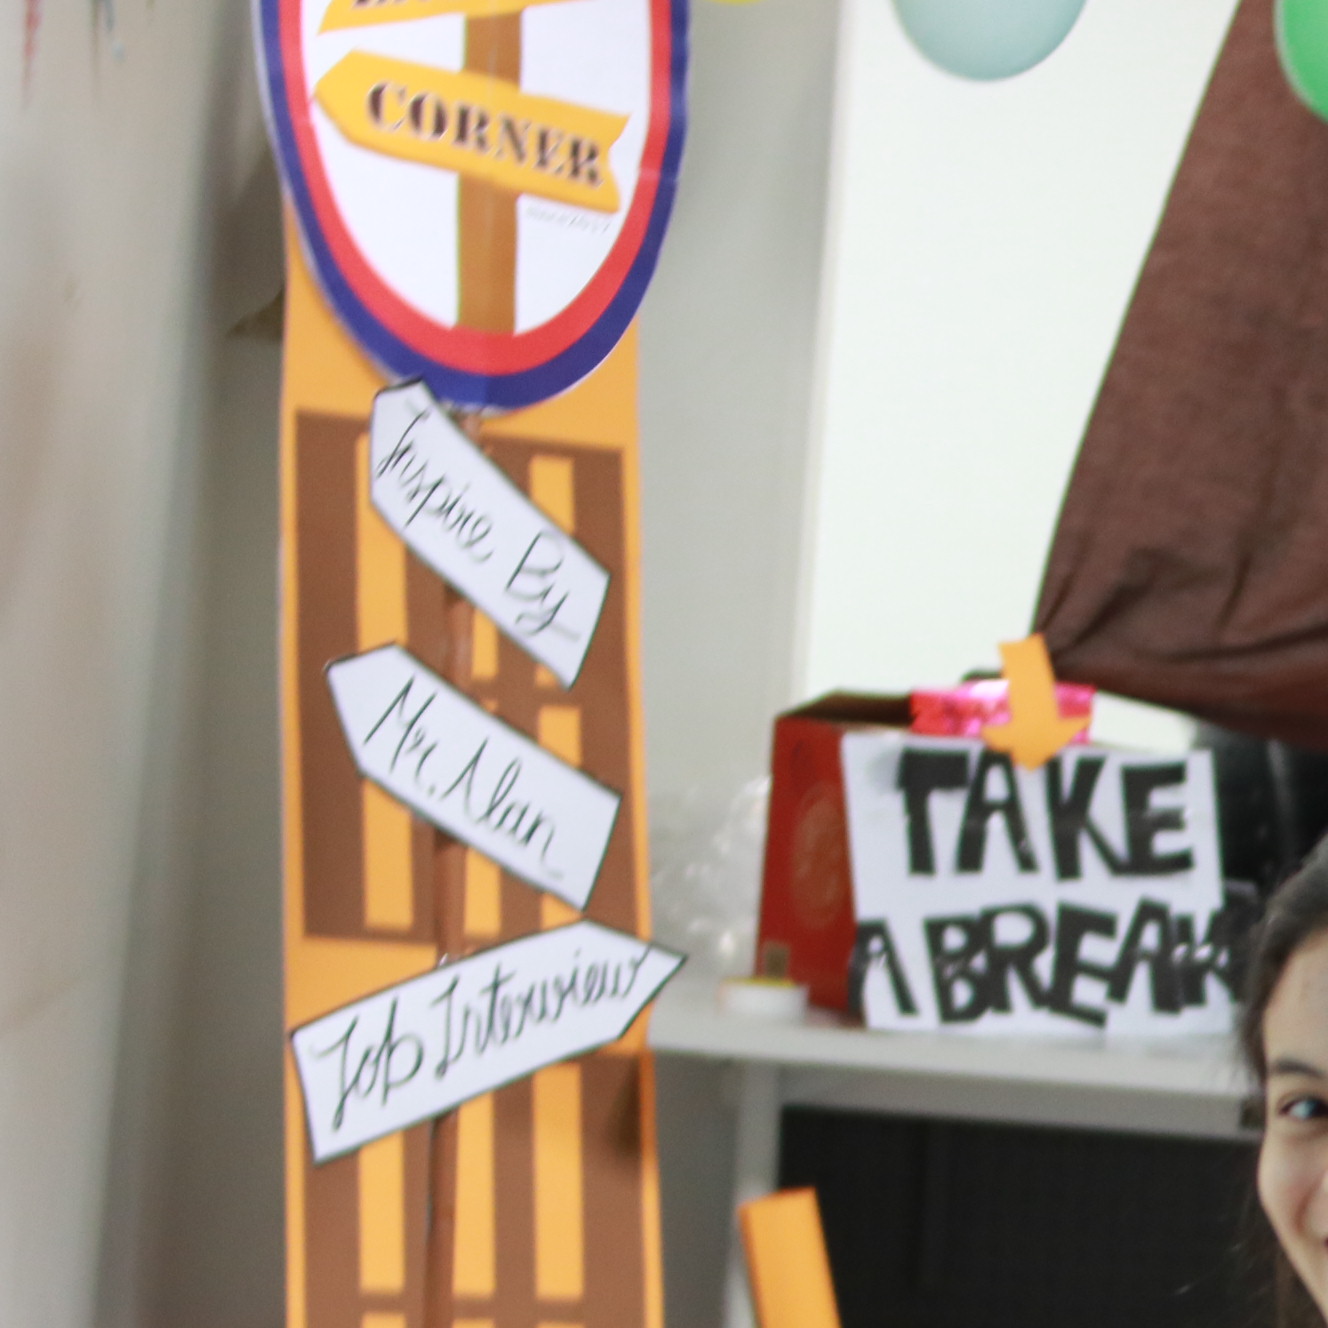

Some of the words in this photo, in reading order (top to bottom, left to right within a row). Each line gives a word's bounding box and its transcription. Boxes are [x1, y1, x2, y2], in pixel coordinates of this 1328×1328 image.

[366, 79, 604, 188] CORNER
[373, 399, 495, 564] Inspire
[506, 529, 582, 640] By
[440, 738, 565, 880] Alan
[898, 747, 1194, 882] TAKE
[849, 919, 918, 1017] A
[923, 896, 1240, 1028] BREAK
[308, 996, 424, 1132] Job
[430, 946, 651, 1080] Interview
